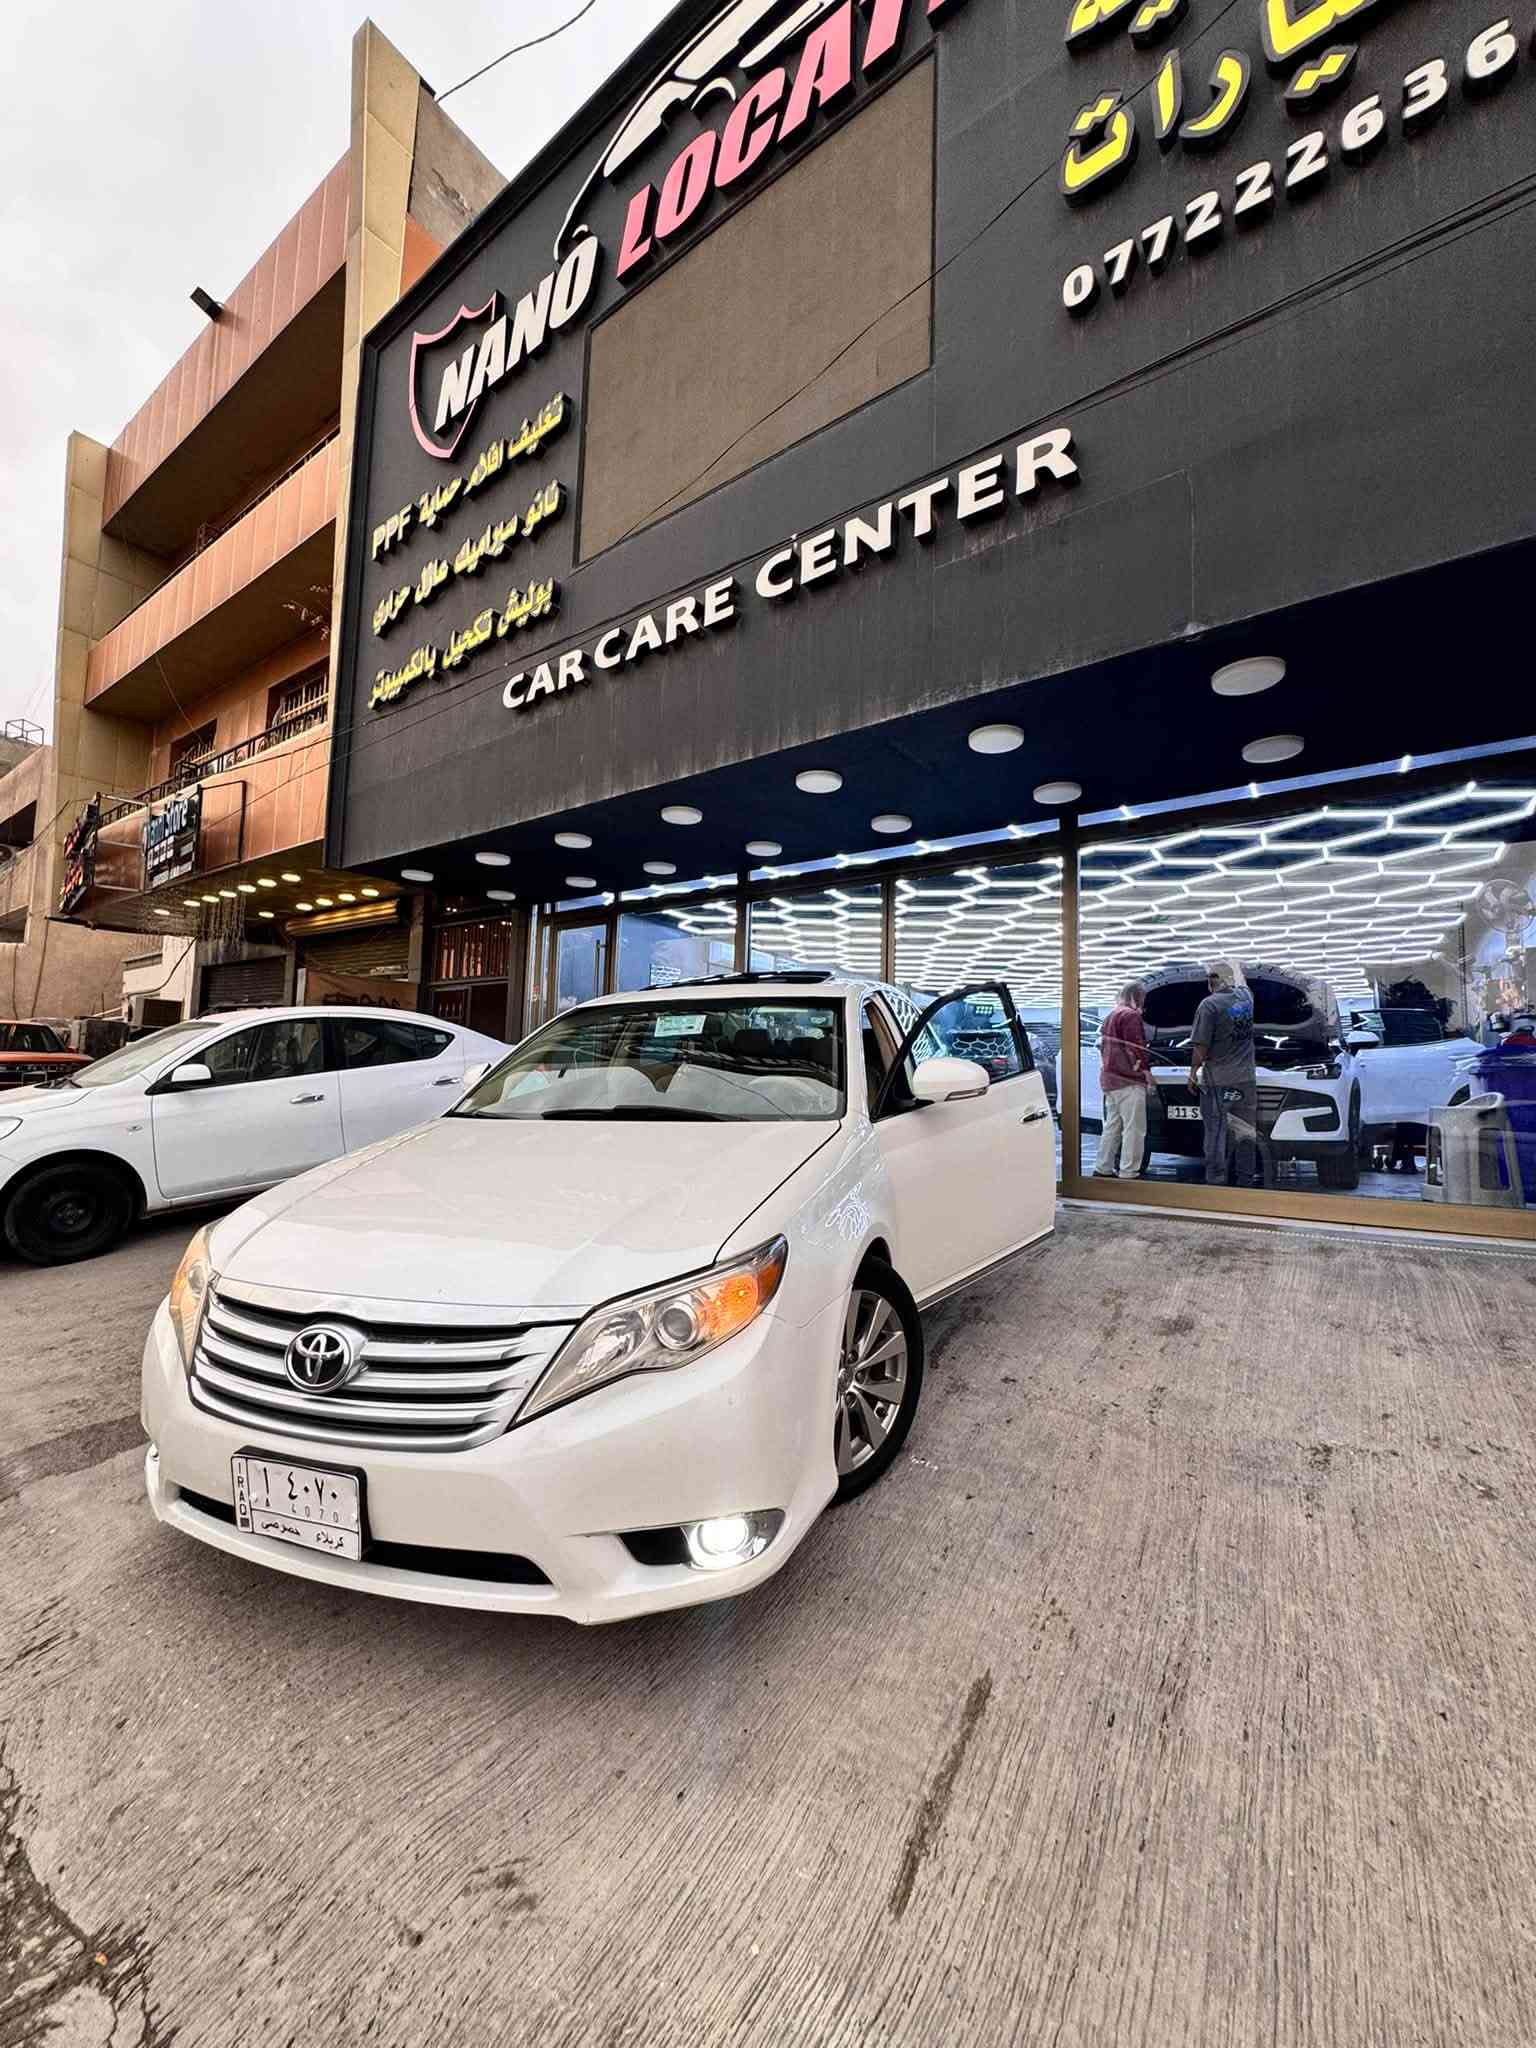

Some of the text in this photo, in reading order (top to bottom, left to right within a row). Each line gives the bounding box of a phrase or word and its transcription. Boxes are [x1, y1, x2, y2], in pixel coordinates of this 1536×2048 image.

[434, 0, 948, 433] NANO LOCAT
[508, 392, 564, 459] تغليف
[372, 503, 413, 560] PPF
[522, 479, 560, 536] نانو
[453, 513, 519, 574] سيراميك
[502, 428, 1078, 709] CAR CARE CENTER
[497, 577, 554, 637] بوليش
[236, 1462, 247, 1516] IRAQ
[287, 1471, 338, 1506] ٤٠٧٠
[315, 1530, 345, 1550] كربلاء
